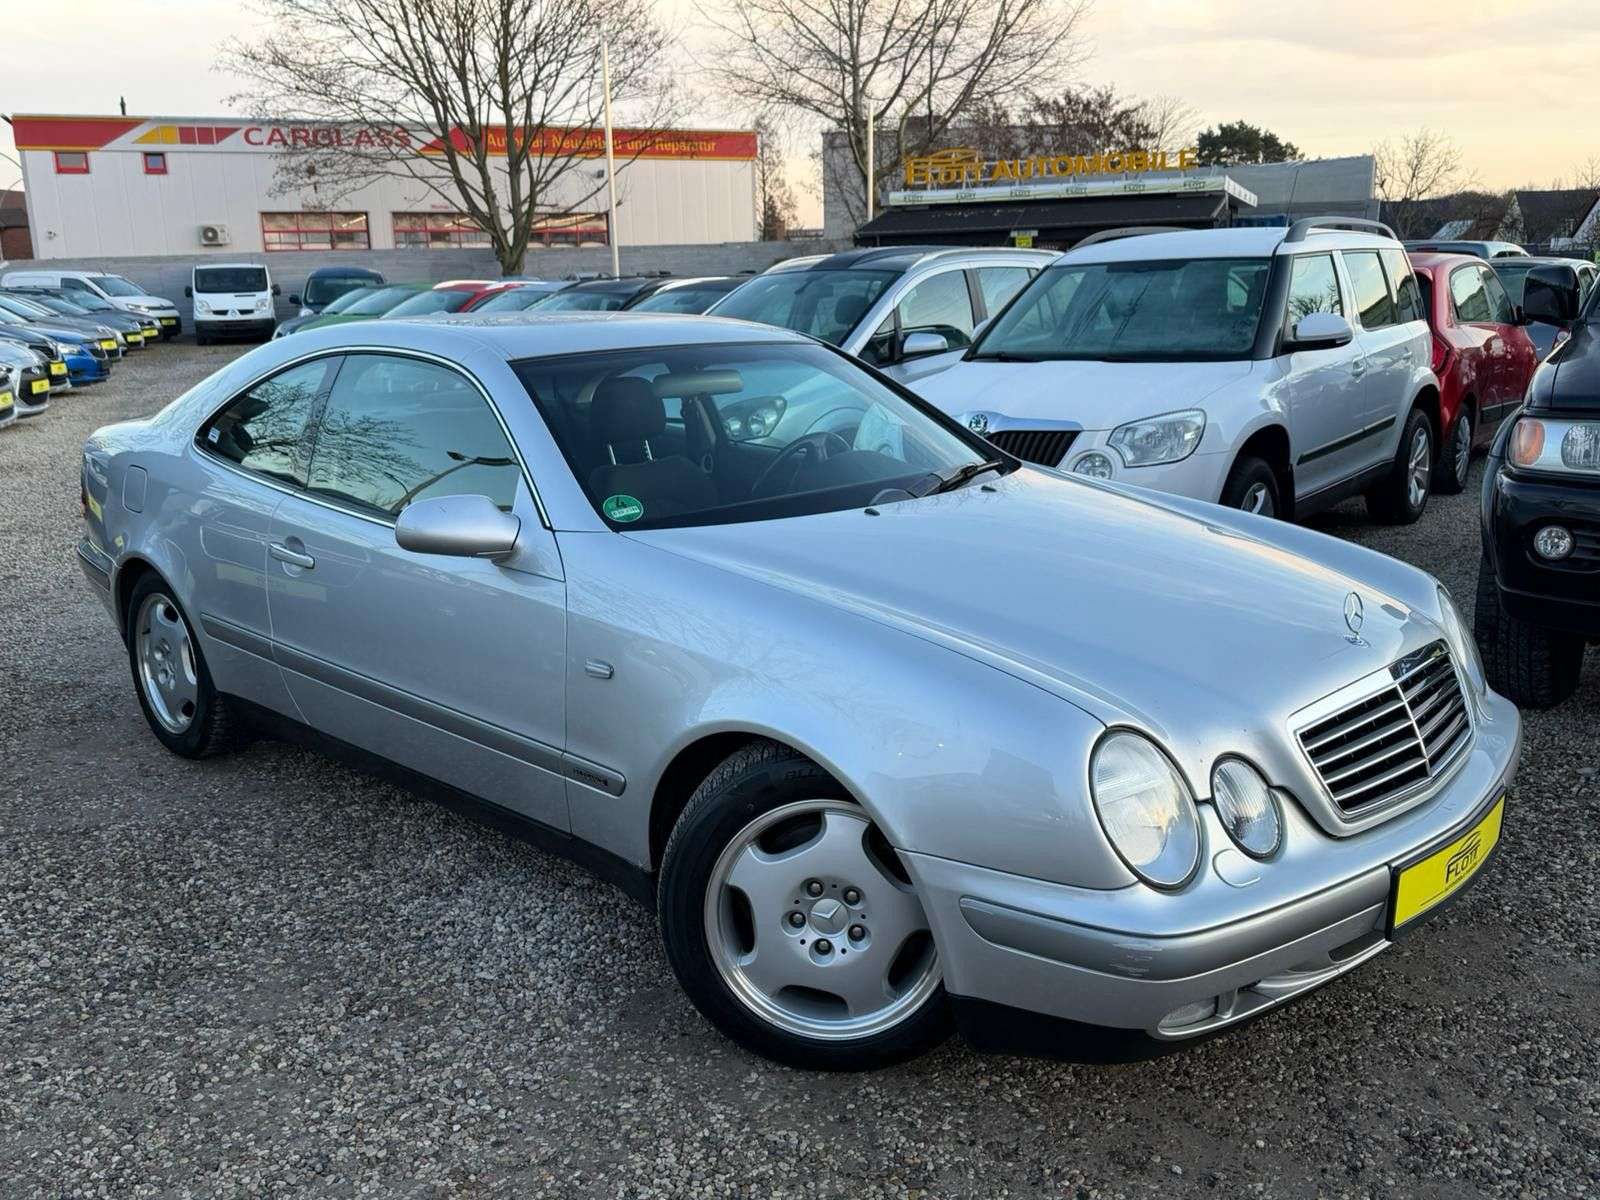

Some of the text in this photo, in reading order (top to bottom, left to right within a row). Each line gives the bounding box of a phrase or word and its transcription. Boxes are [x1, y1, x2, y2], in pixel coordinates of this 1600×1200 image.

[552, 134, 621, 150] Neueinbu
[655, 138, 717, 154] Reparatur
[991, 147, 1198, 181] AUTOMOBILE
[1446, 844, 1480, 884] FLOTT
